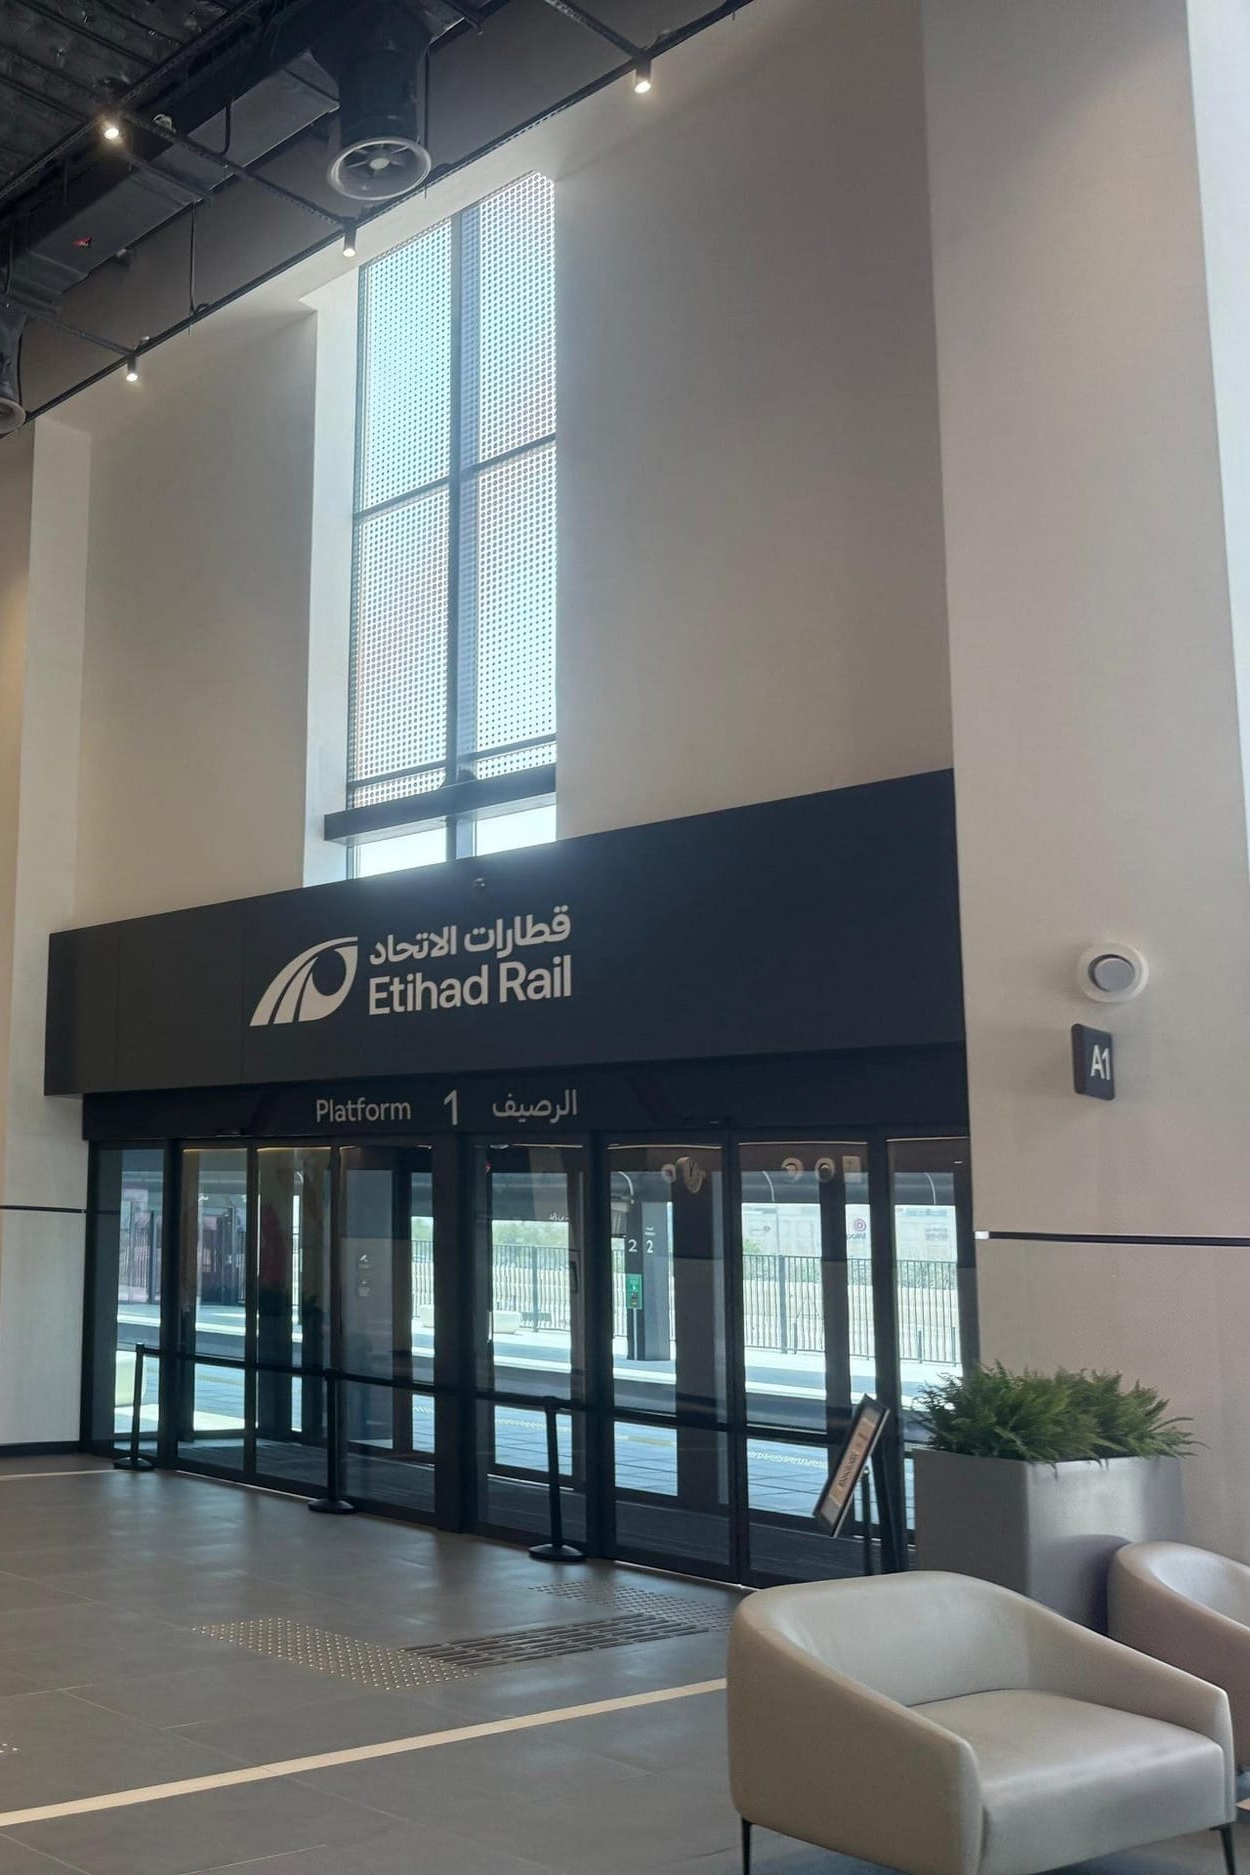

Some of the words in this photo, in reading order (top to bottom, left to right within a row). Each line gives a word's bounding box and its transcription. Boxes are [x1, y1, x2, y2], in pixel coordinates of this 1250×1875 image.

[369, 925, 458, 965] الاتحاد
[464, 905, 571, 958] قطارات
[368, 964, 489, 1016] Etihad
[499, 955, 572, 1003] Rail
[1090, 1045, 1111, 1081] A1
[316, 1098, 411, 1123] Platform
[443, 1089, 458, 1126] 1
[492, 1089, 577, 1123] الرصيف
[628, 1239, 638, 1252] 2
[646, 1239, 654, 1253] 2
